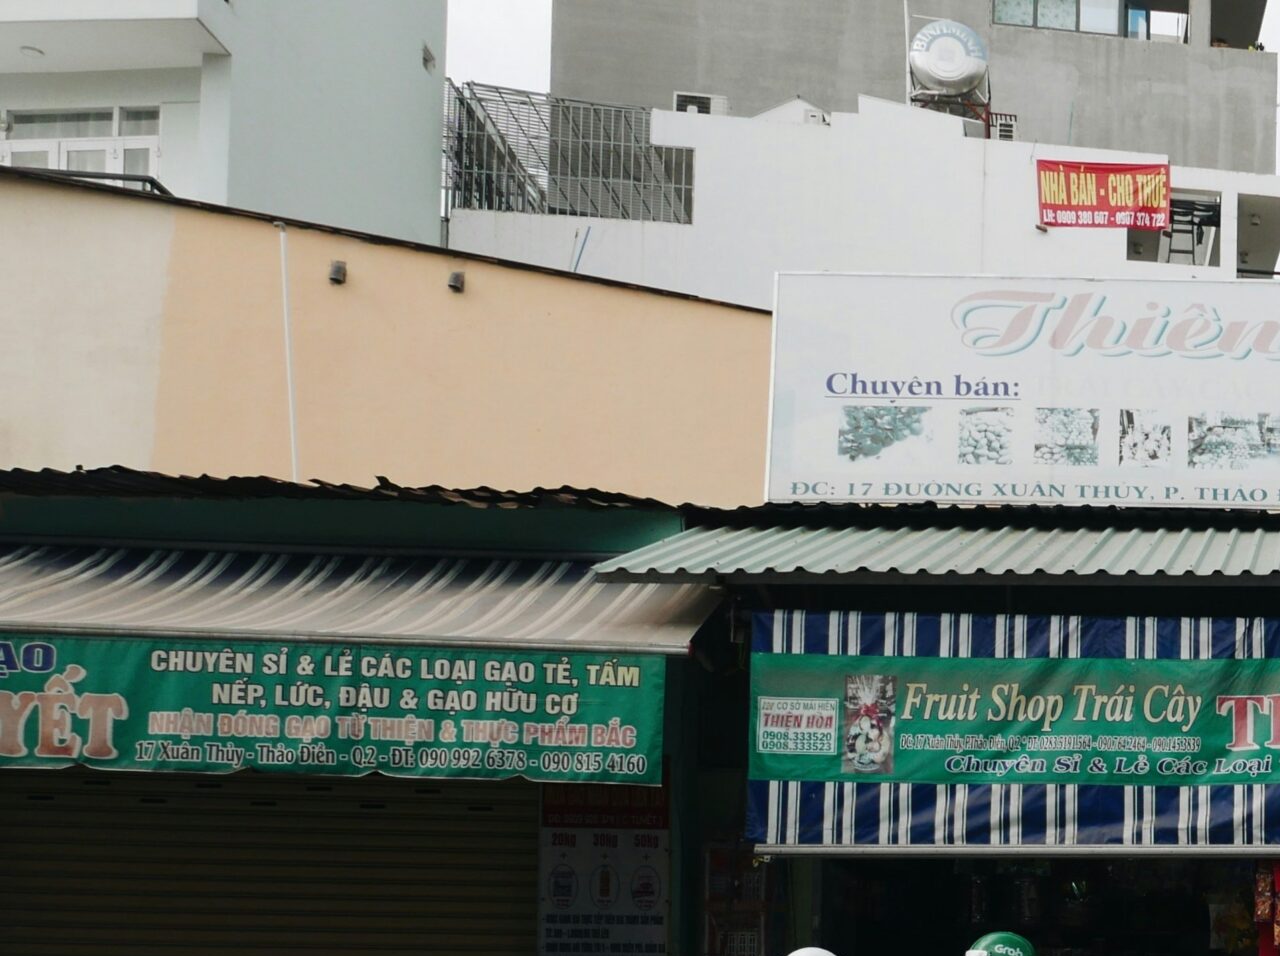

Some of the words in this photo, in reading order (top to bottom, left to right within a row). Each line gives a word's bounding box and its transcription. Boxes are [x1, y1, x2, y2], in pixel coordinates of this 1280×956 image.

[1040, 165, 1067, 205] NHÀ
[1070, 166, 1096, 206] BÁN
[1108, 174, 1133, 206] CHO
[1136, 168, 1166, 208] THUÊ
[825, 372, 943, 403] Chuyên
[954, 374, 1019, 397] bán:
[789, 481, 835, 496] ĐC:
[848, 482, 873, 496] 17
[1164, 486, 1185, 500] P.
[151, 647, 253, 674] CHUYÊN
[296, 655, 315, 676] &
[324, 649, 353, 676] LẺ
[360, 653, 412, 678] CÁC
[420, 658, 476, 685] LOẠI
[484, 660, 535, 686] GẠO
[543, 657, 579, 687] TẺ,
[586, 658, 640, 687] TẤM
[211, 677, 267, 708] NẾP,
[338, 683, 390, 712] ĐẬU
[399, 689, 418, 710] &
[427, 690, 477, 715] GẠO
[485, 687, 537, 713] HỮU
[544, 692, 579, 715] CƠ
[900, 683, 981, 721] Fruit
[987, 683, 1064, 732] Shop
[1072, 683, 1136, 722] Trái
[1143, 684, 1202, 732] Cây
[148, 707, 214, 740] NHẬN
[285, 714, 330, 743] GẠO
[368, 713, 434, 746] THIỆN
[439, 720, 457, 742] &
[461, 719, 519, 749] THỰC
[591, 717, 637, 748] BẮC
[762, 731, 832, 741] 0908.333520
[136, 741, 156, 761] 17
[158, 740, 201, 763] Xuân
[204, 741, 245, 766] Thủy
[257, 743, 295, 764] Thảo
[299, 742, 336, 765] Điền
[352, 746, 376, 766] Q.2
[391, 746, 415, 767] ĐT:
[419, 748, 447, 768] 090
[452, 748, 481, 768] 992
[486, 749, 526, 770] 6378
[541, 751, 571, 772] 090
[575, 752, 602, 772] 815
[607, 753, 647, 774] 4160
[762, 741, 831, 751] 0908.333523
[945, 754, 1046, 776] Chuyên
[1087, 757, 1108, 773] &
[1113, 754, 1150, 774] Lẻ
[1157, 755, 1208, 775] Các
[1213, 754, 1272, 776] Loại
